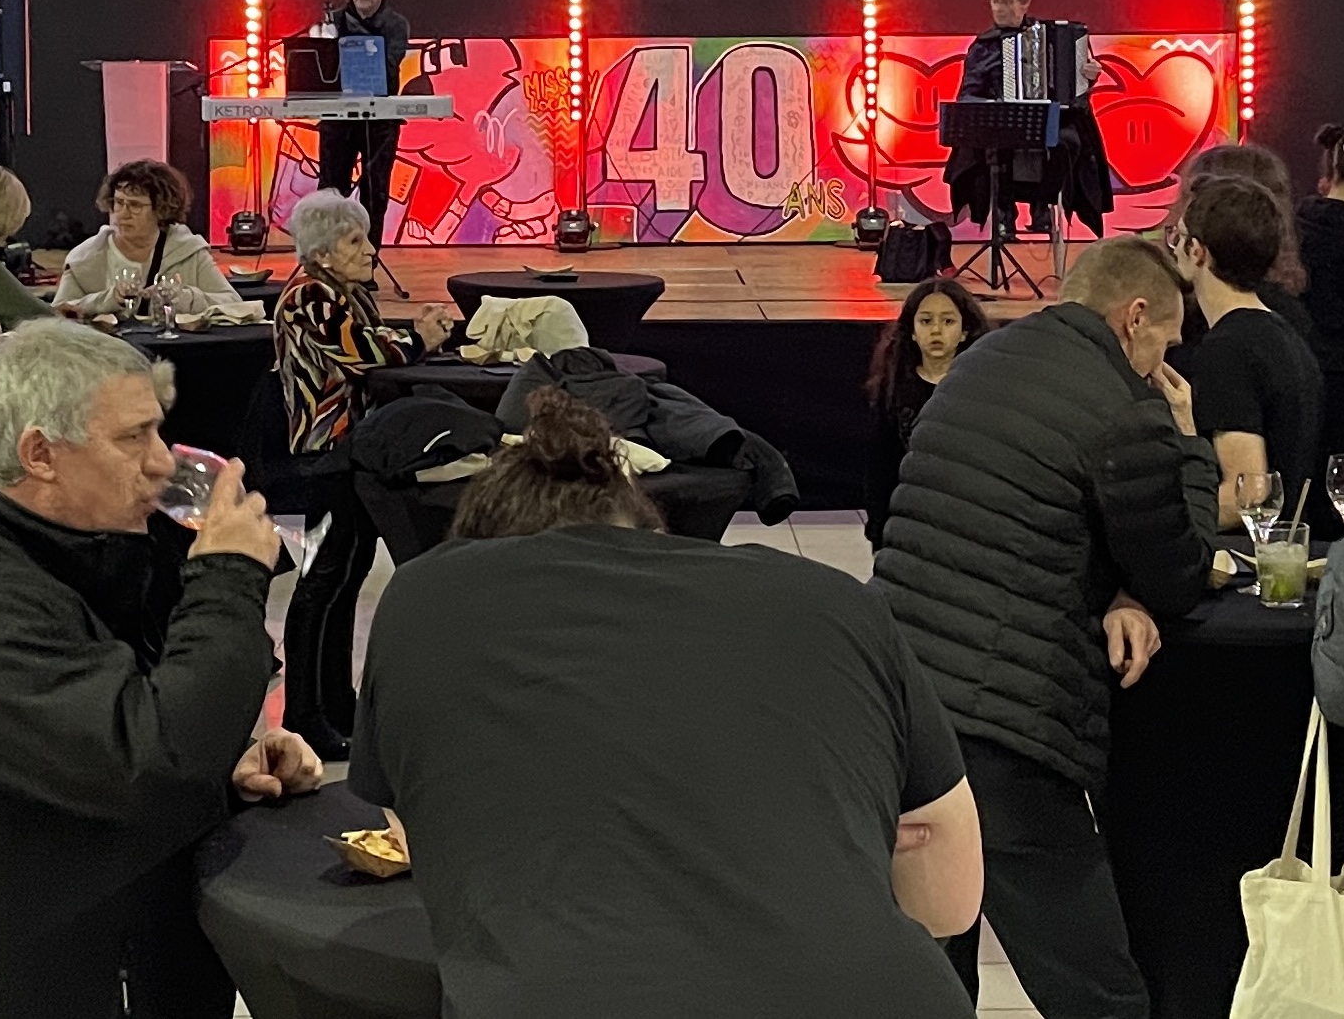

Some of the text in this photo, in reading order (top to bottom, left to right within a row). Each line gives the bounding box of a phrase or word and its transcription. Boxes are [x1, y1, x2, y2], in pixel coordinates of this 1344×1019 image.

[214, 105, 273, 117] KETRON
[601, 43, 816, 228] 40
[783, 180, 847, 220] ANS
